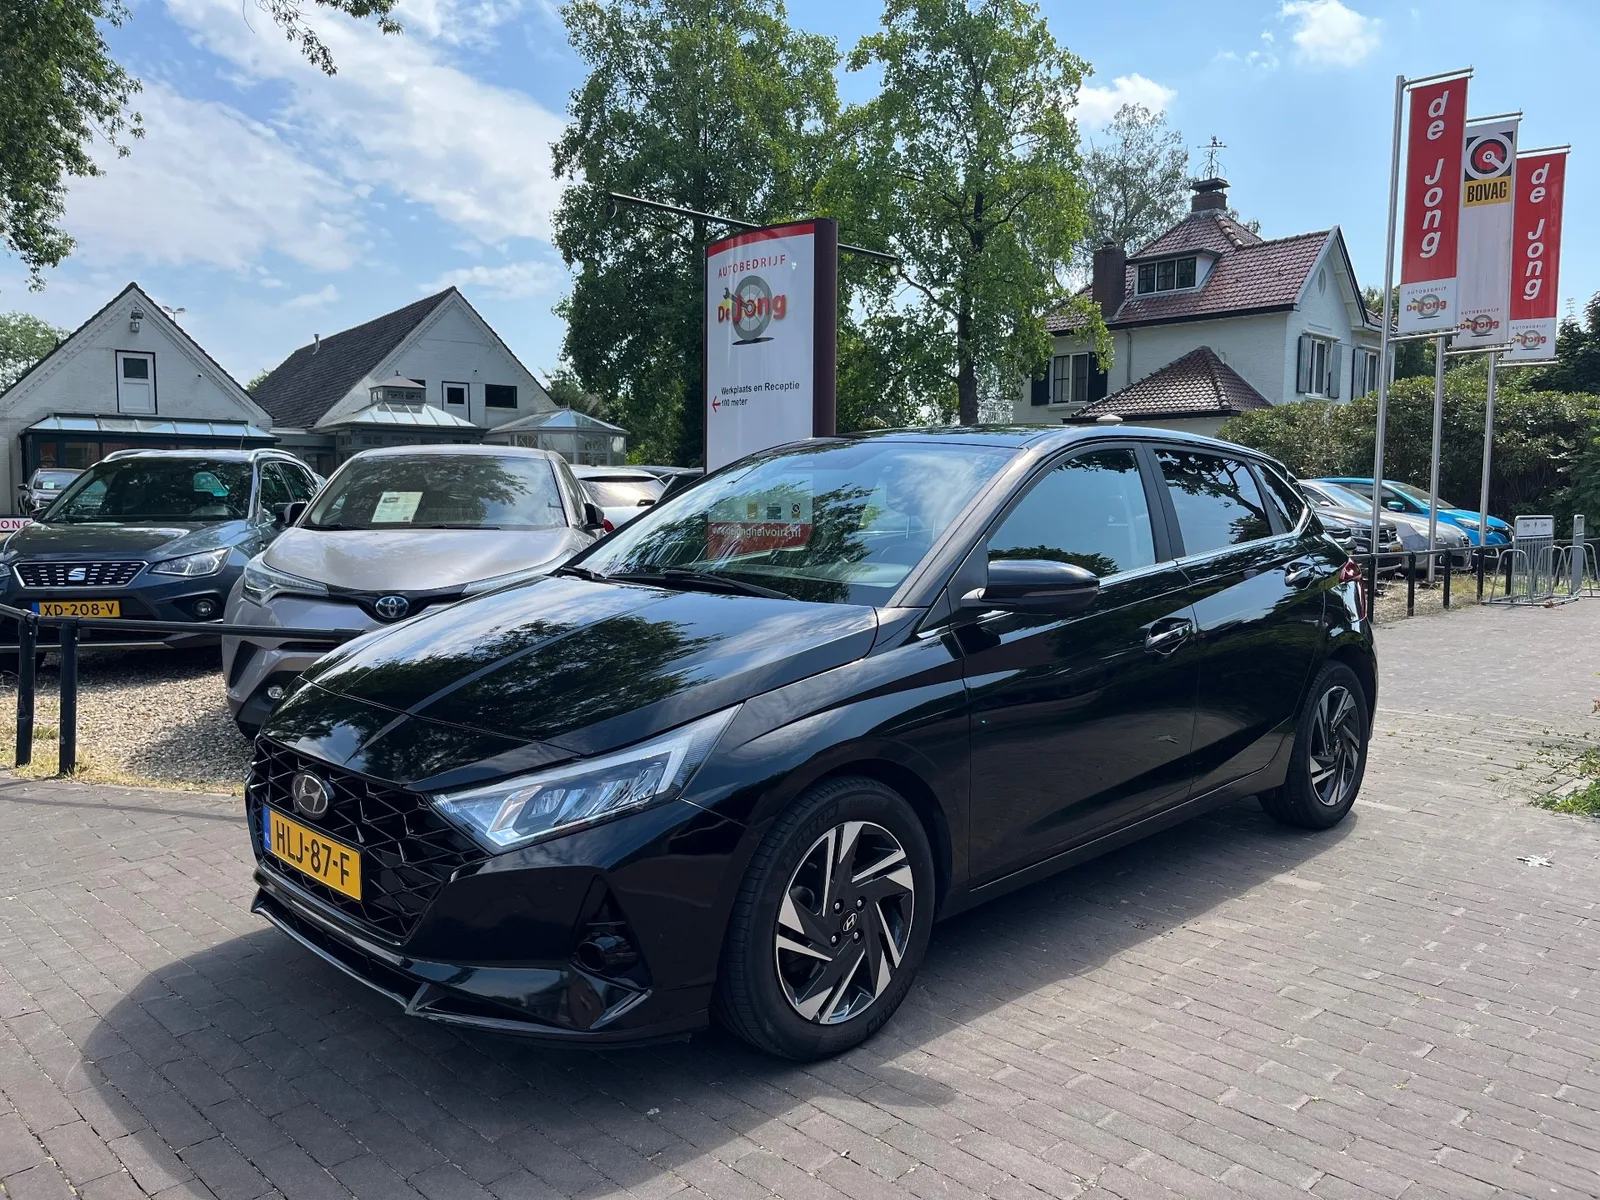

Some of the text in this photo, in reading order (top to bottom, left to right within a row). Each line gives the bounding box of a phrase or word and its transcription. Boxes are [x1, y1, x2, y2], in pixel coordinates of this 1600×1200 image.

[1419, 90, 1449, 259] de Jong
[1467, 181, 1507, 203] BOVAG
[1523, 163, 1550, 301] de Jong
[718, 254, 786, 279] AUTOBEDRIJF
[721, 380, 800, 396] Werkplaats en Receptie
[731, 398, 748, 407] meter
[43, 603, 115, 617] XD-208-V
[275, 819, 350, 887] HLJ-87-F
